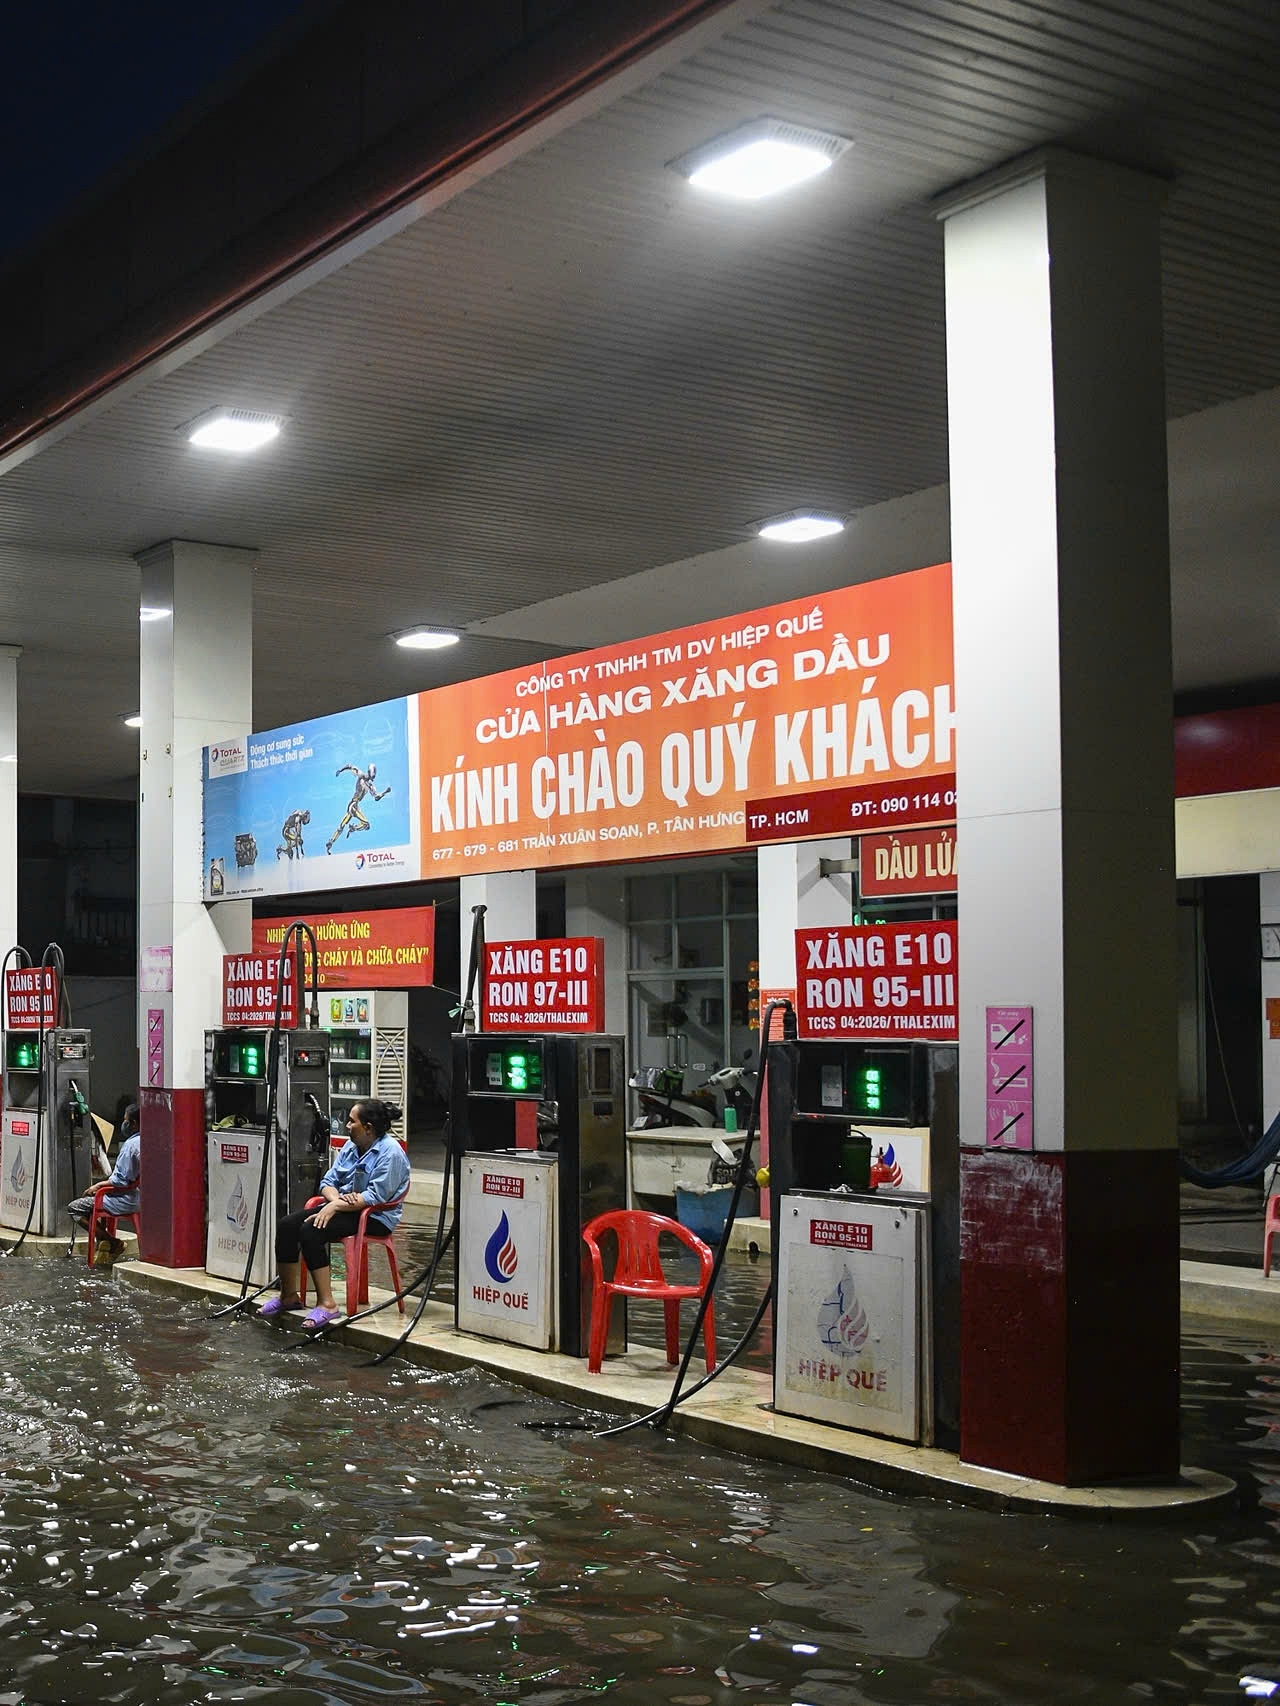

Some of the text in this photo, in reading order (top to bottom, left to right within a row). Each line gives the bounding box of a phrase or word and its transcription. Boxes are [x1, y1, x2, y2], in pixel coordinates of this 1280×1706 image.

[516, 606, 823, 697] CÔNG TY TNHH TM DV HIỆP QUẾ
[475, 632, 890, 743] CỬA HÀNG XĂNG DẦU
[220, 747, 241, 758] TOTAL
[250, 744, 266, 757] Động
[431, 676, 957, 833] KÍNH CHÀO QUÝ KHÁCH
[250, 757, 269, 769] Thách
[749, 790, 957, 829] TP. HCM ĐT: 090 114 0
[432, 810, 746, 860] 677 679 681 TRẦN XUÂN SOẠN, P. TÂN HƯNG
[367, 853, 395, 862] TOTAL
[875, 831, 958, 881] DẦU LỬ
[317, 919, 348, 940] HƯỞNG
[350, 922, 370, 940] ỨNG
[323, 947, 348, 966] CHÁY
[350, 949, 363, 966] VÀ
[366, 947, 393, 965] CHỮA
[489, 945, 587, 975] XĂNG E10
[806, 932, 952, 970] XĂNG E10
[227, 957, 262, 981] XĂNG
[267, 958, 291, 979] E10
[9, 972, 51, 991] XĂNG E0
[806, 974, 954, 1009] RON 95-III
[10, 995, 53, 1012] RON 95III
[227, 985, 291, 1007] RON 95-II
[488, 980, 588, 1006] RON 97-III
[227, 1012, 240, 1021] TCCS
[489, 1012, 508, 1024] TCCS
[807, 1016, 836, 1030] TCCS
[893, 1015, 955, 1029] THALEXIM
[815, 1221, 867, 1234] XĂNG E10
[815, 1231, 867, 1243] RON 95-III
[473, 1285, 528, 1310] HIỆP QUẾ
